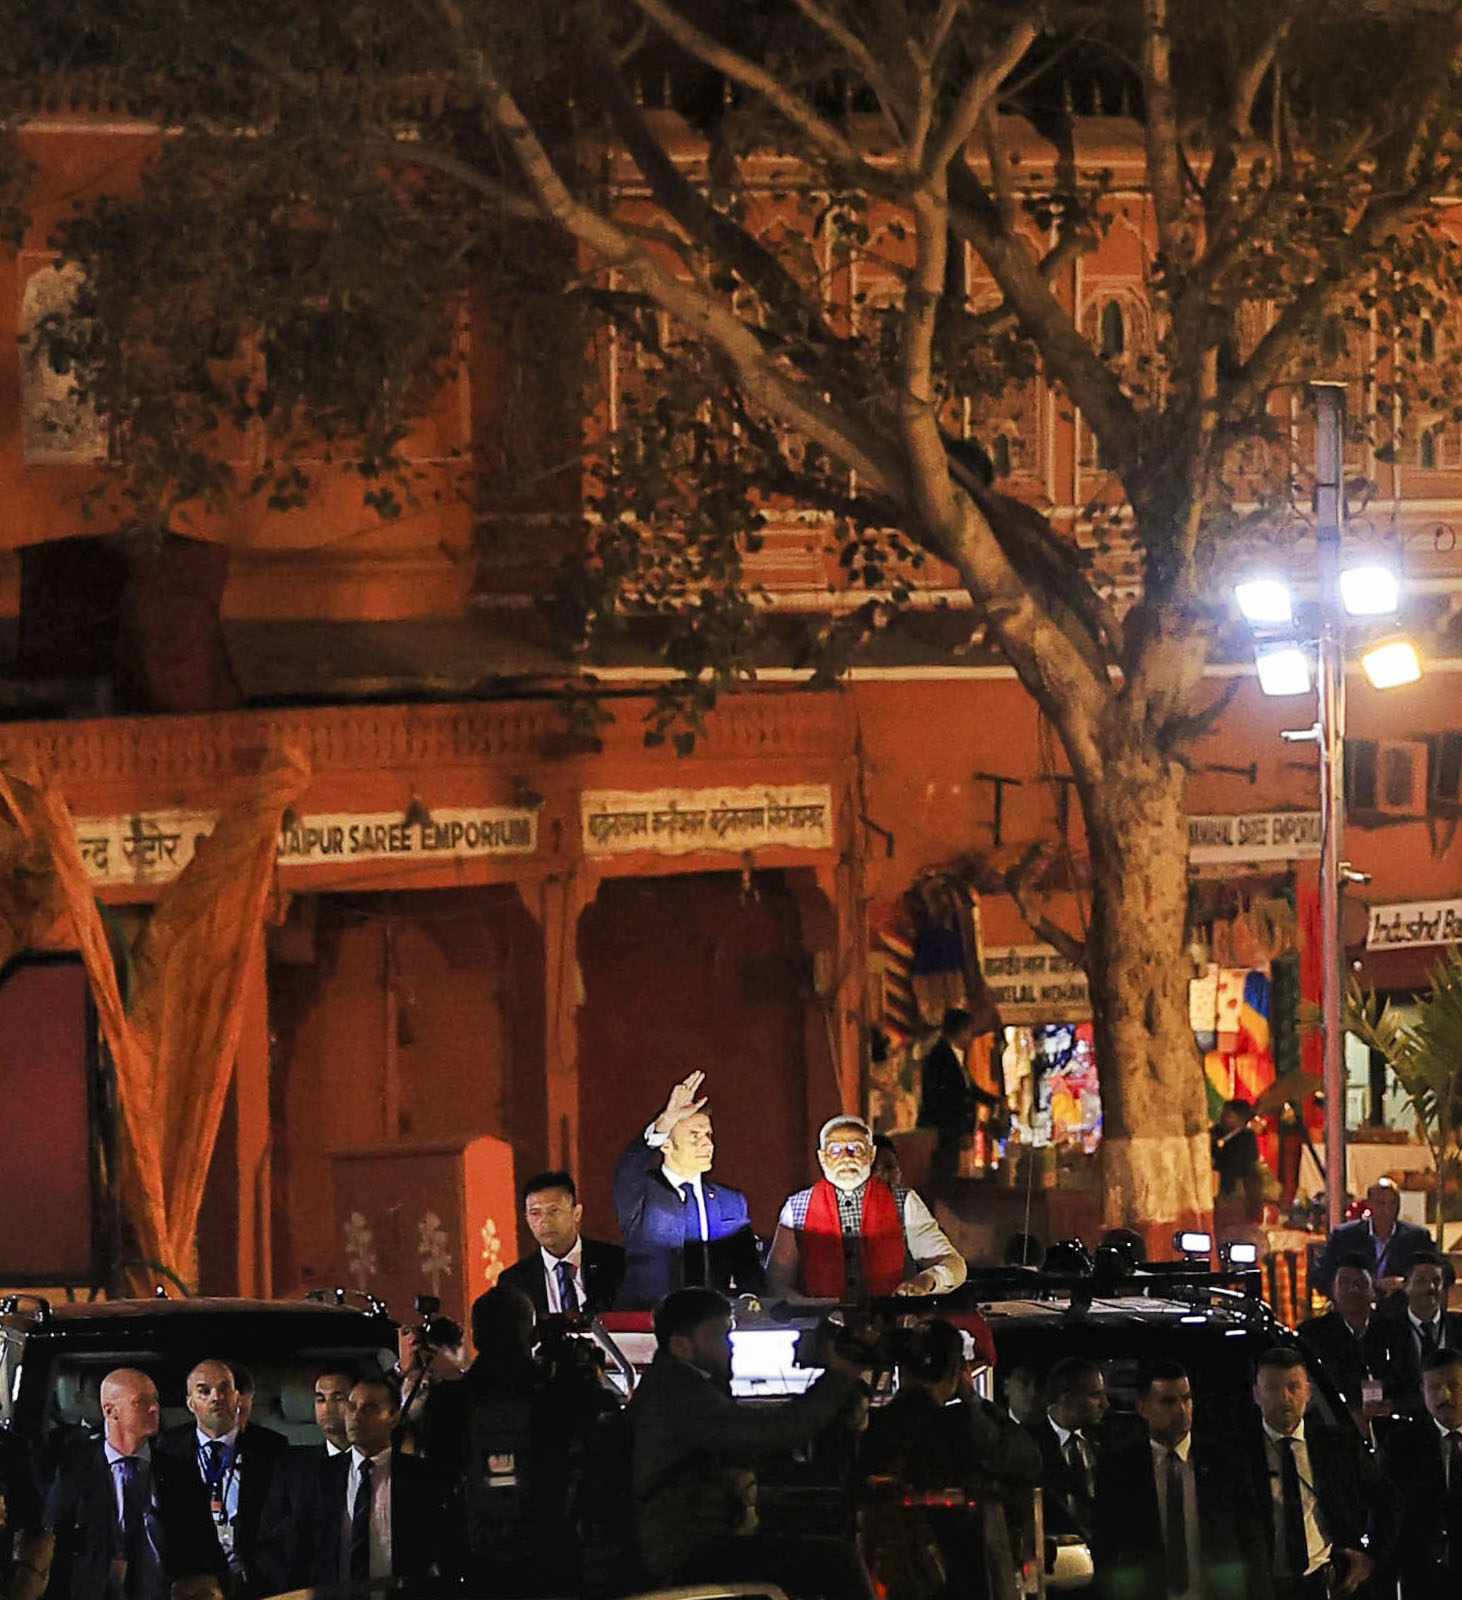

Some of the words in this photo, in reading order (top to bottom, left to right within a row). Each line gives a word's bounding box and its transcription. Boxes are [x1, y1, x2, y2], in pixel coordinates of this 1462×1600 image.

[277, 825, 344, 855] JAIPUR
[349, 823, 412, 854] SAREE
[420, 817, 532, 850] EMPORIUM
